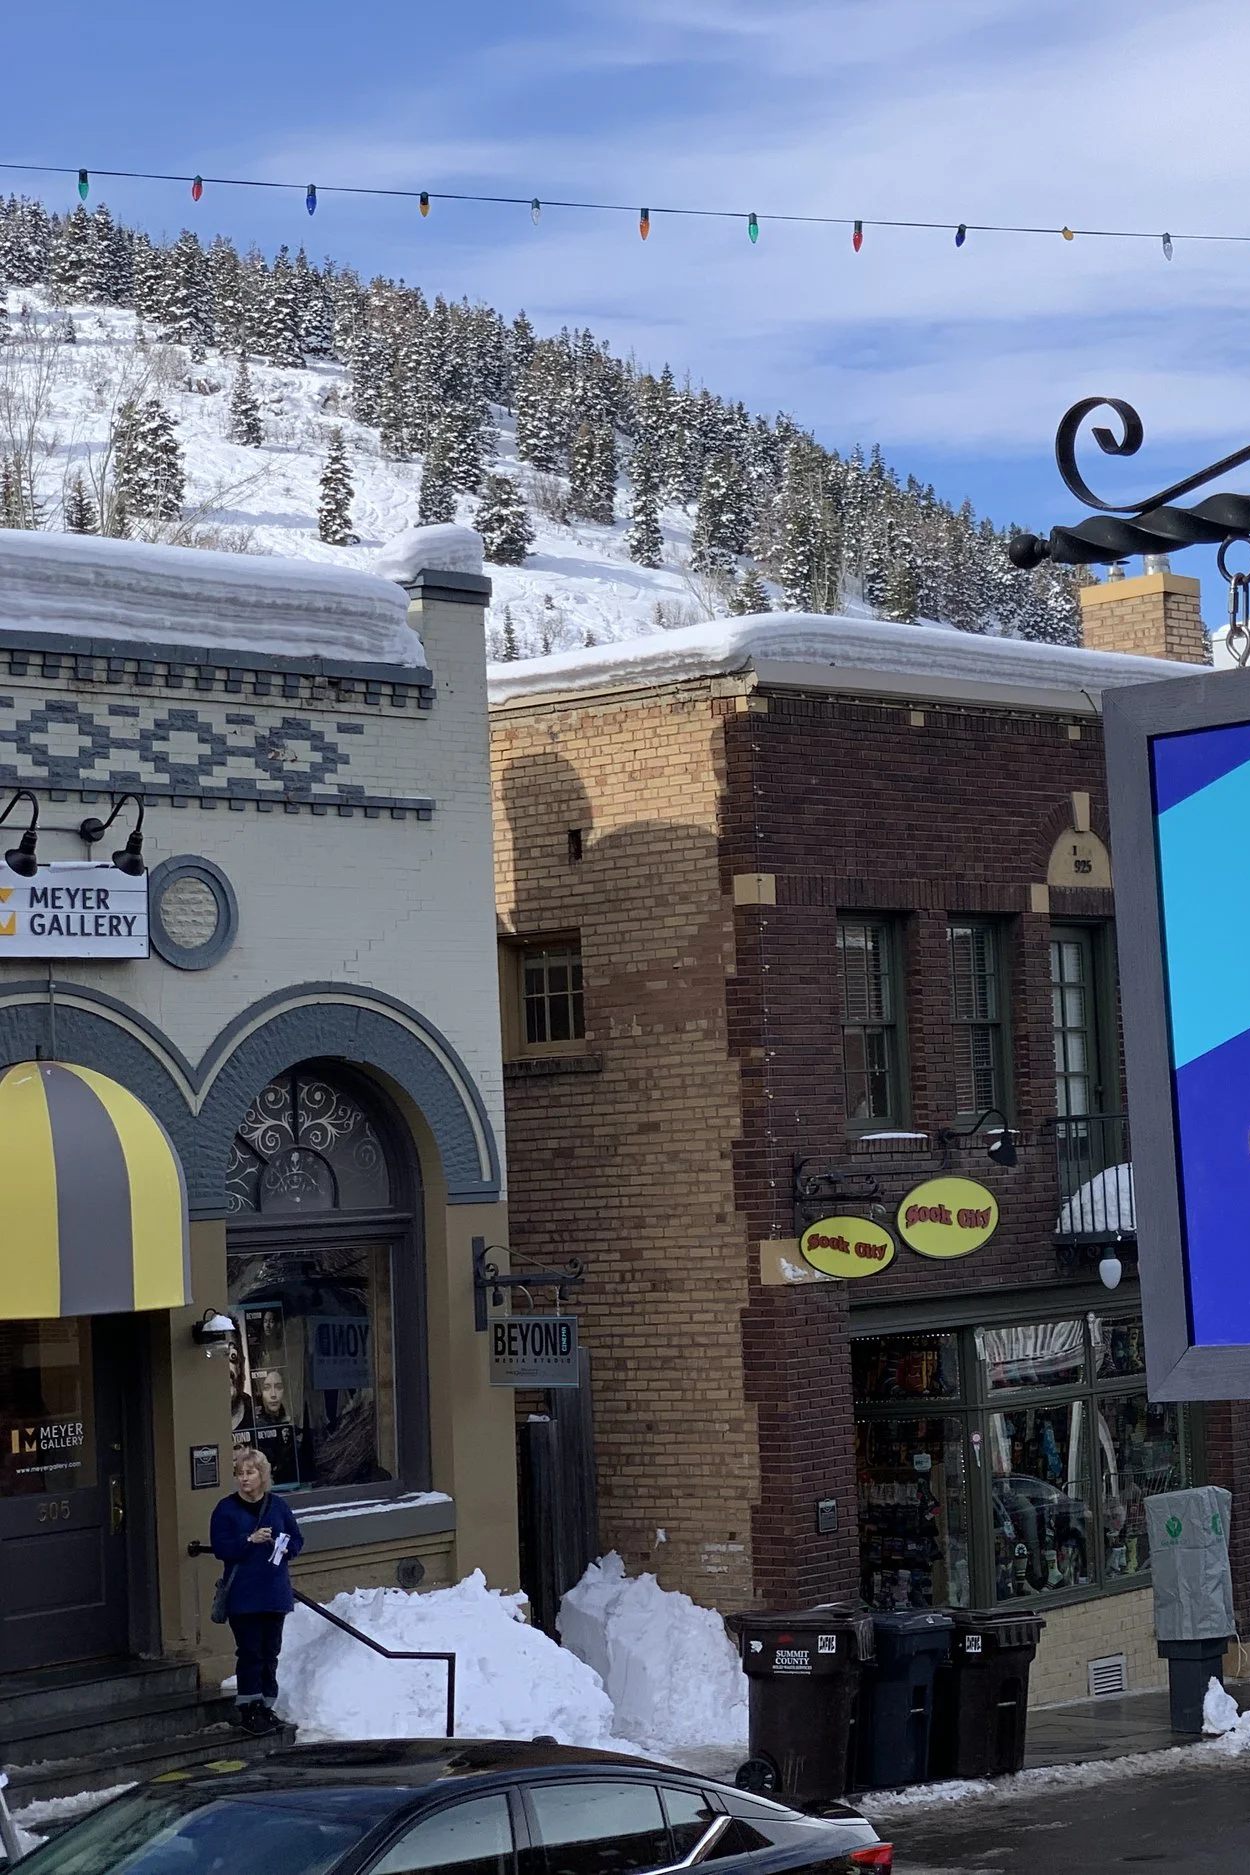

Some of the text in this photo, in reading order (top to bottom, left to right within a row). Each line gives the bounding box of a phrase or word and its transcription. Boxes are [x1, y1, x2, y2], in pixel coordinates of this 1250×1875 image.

[1074, 859, 1092, 874] 925
[29, 886, 110, 910] MEYER
[29, 913, 137, 937] GALLERY
[905, 1204, 992, 1229] Sock City
[807, 1233, 888, 1260] Sock City
[493, 1322, 572, 1356] BEYOND
[40, 1422, 84, 1440] MEYER
[232, 1431, 251, 1443] YOND
[257, 1428, 277, 1440] BEYOND
[40, 1436, 84, 1450] GALLERY
[16, 1461, 82, 1474] www.meyergallery.com
[775, 1650, 810, 1658] SUMMIT
[775, 1657, 810, 1665] COUNTY
